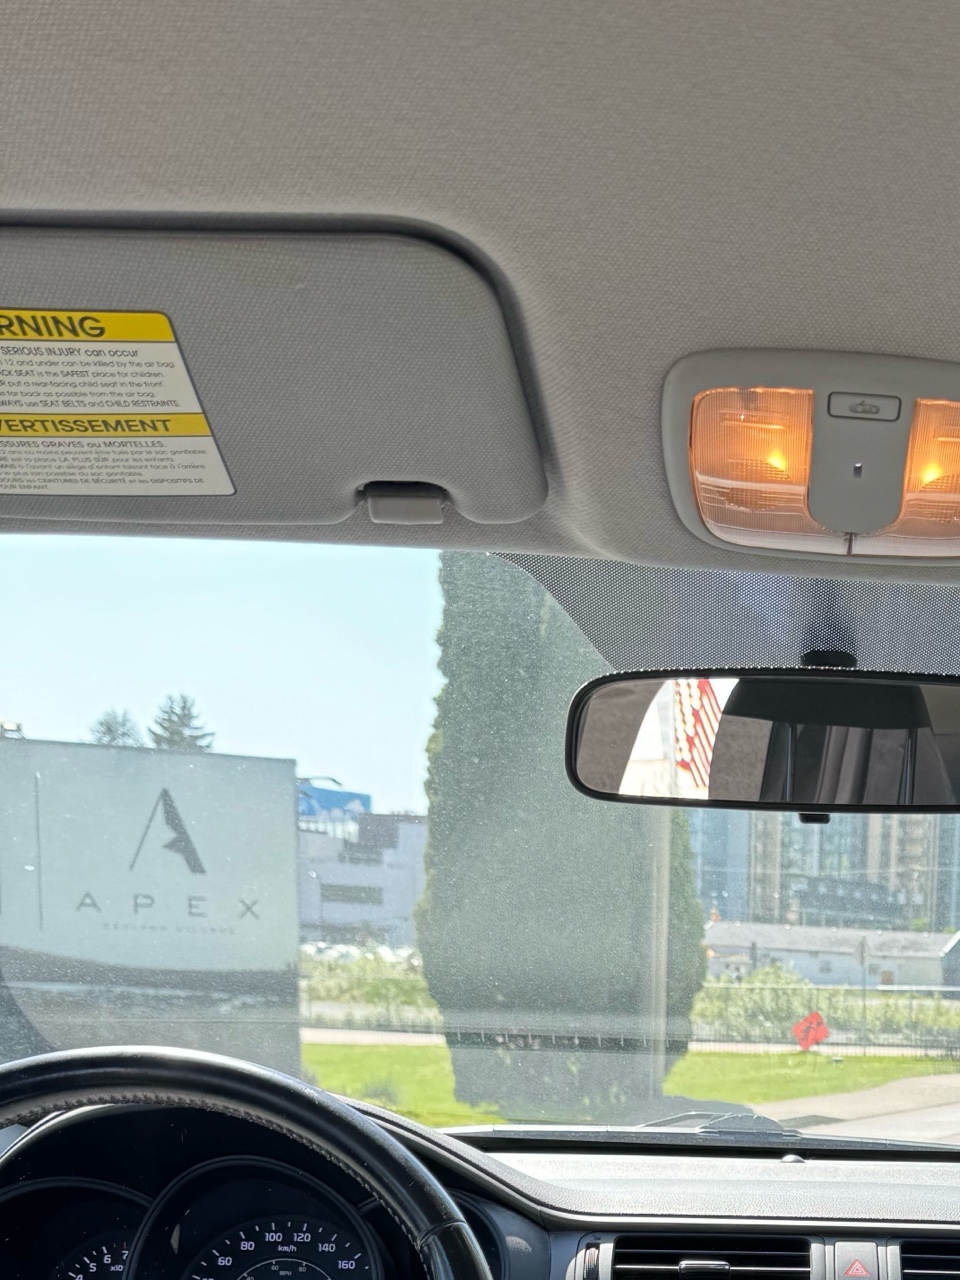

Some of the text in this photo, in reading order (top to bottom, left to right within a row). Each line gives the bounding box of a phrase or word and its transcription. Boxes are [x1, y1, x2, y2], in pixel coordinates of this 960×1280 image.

[0, 346, 44, 355] SERIOUS
[45, 347, 81, 356] INJURY
[116, 360, 126, 368] by
[0, 419, 171, 432] ERTISSEMENT
[76, 889, 260, 920] APEX
[265, 1233, 283, 1242] 100
[293, 1233, 311, 1242] 120
[240, 1241, 255, 1250] 80
[278, 1244, 297, 1252] km/h
[318, 1243, 336, 1252] 140
[103, 1255, 111, 1263] 6
[122, 1250, 129, 1260] 7
[218, 1257, 232, 1266] 60
[338, 1260, 355, 1269] 160
[89, 1263, 97, 1272] 5
